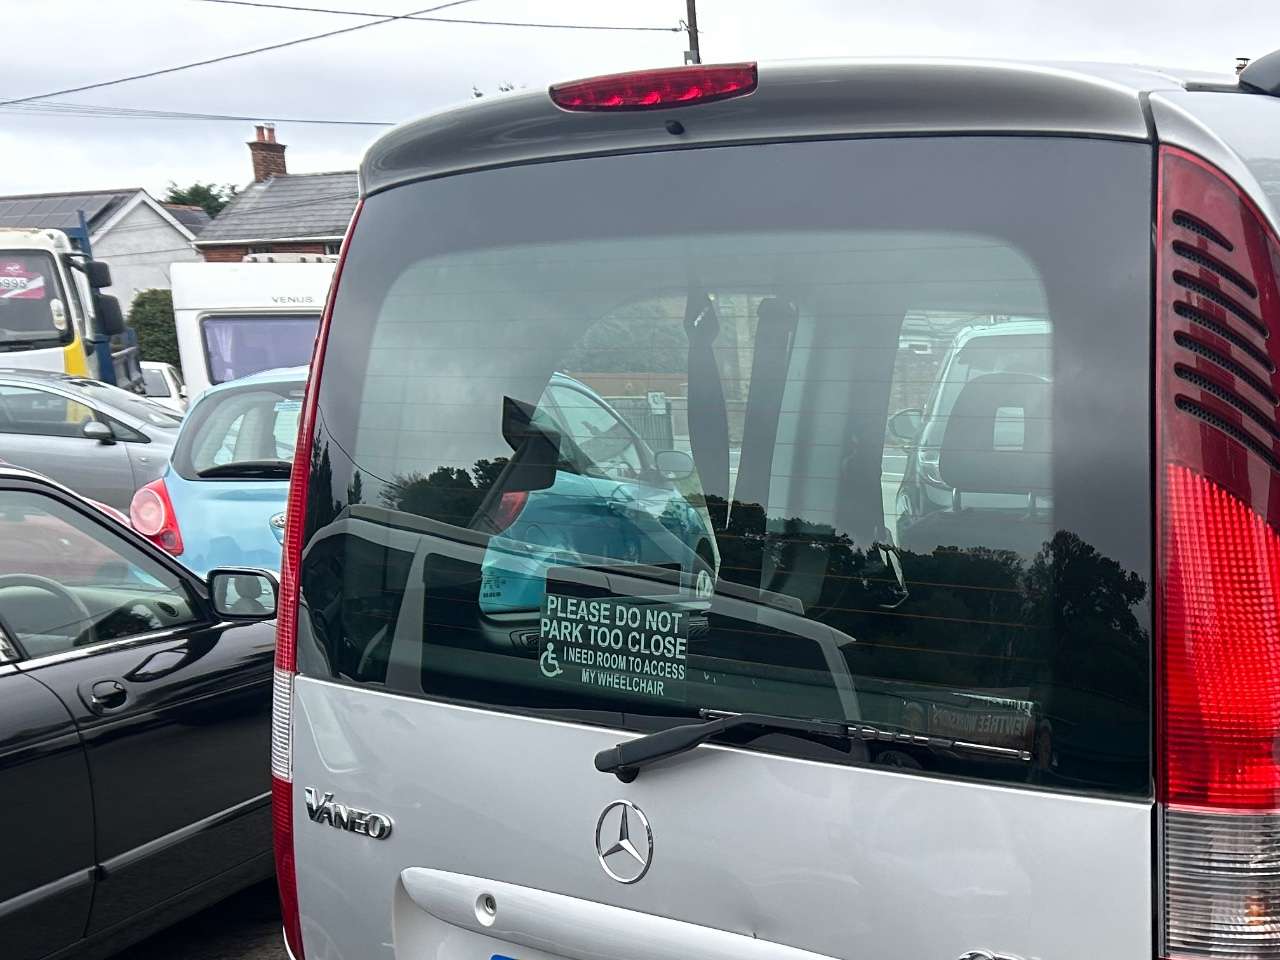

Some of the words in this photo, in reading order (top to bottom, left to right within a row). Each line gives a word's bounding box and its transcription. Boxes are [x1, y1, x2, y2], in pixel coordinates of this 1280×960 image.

[271, 296, 314, 304] VENUS
[547, 596, 611, 624] PLEASE
[615, 605, 641, 628] DO
[645, 609, 683, 634] NOT
[540, 618, 583, 644] PARK
[588, 626, 624, 650] TOO
[628, 631, 687, 660] CLOSE
[563, 647, 567, 661] I
[568, 647, 595, 666] NEED
[596, 651, 626, 671] ROOM
[628, 656, 642, 673] TO
[643, 660, 685, 680] ACCESS
[581, 668, 595, 685] MY
[597, 671, 664, 696] WHEELCHAIR
